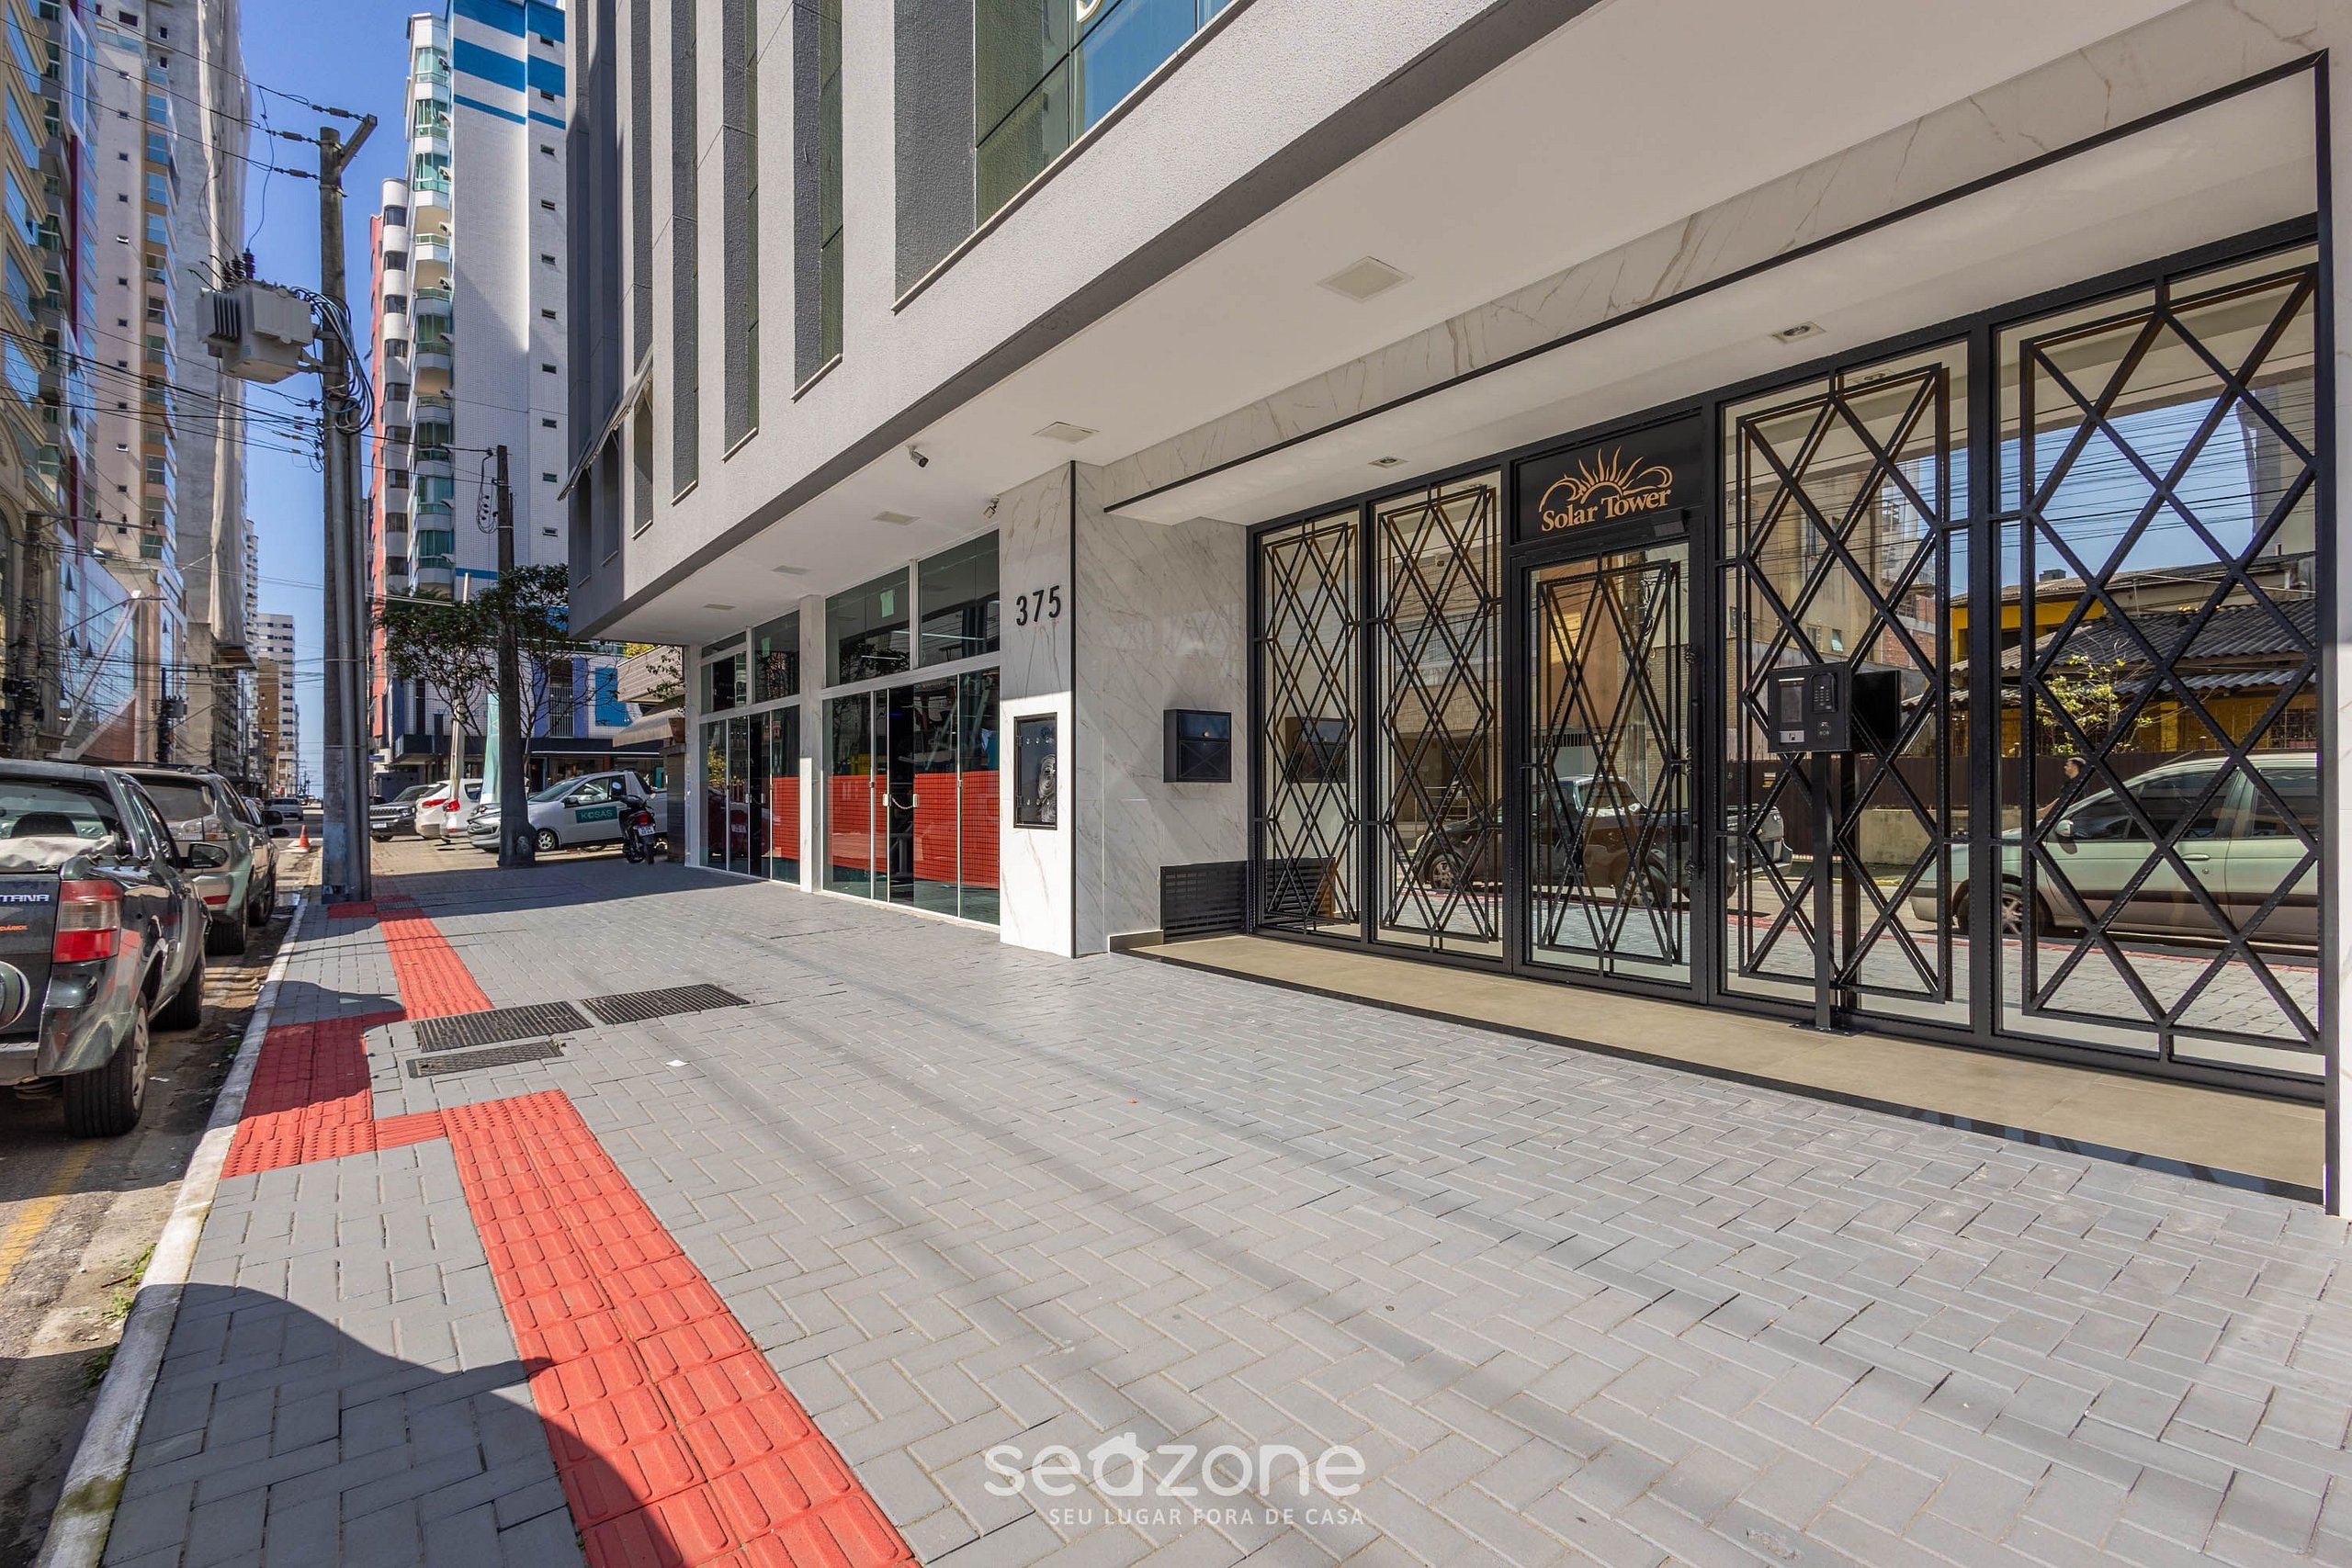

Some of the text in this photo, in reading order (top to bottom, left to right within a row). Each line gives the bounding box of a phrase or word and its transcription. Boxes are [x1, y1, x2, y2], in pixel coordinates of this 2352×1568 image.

[1541, 489, 1672, 532] Solar Tower
[1016, 585, 1061, 626] 375
